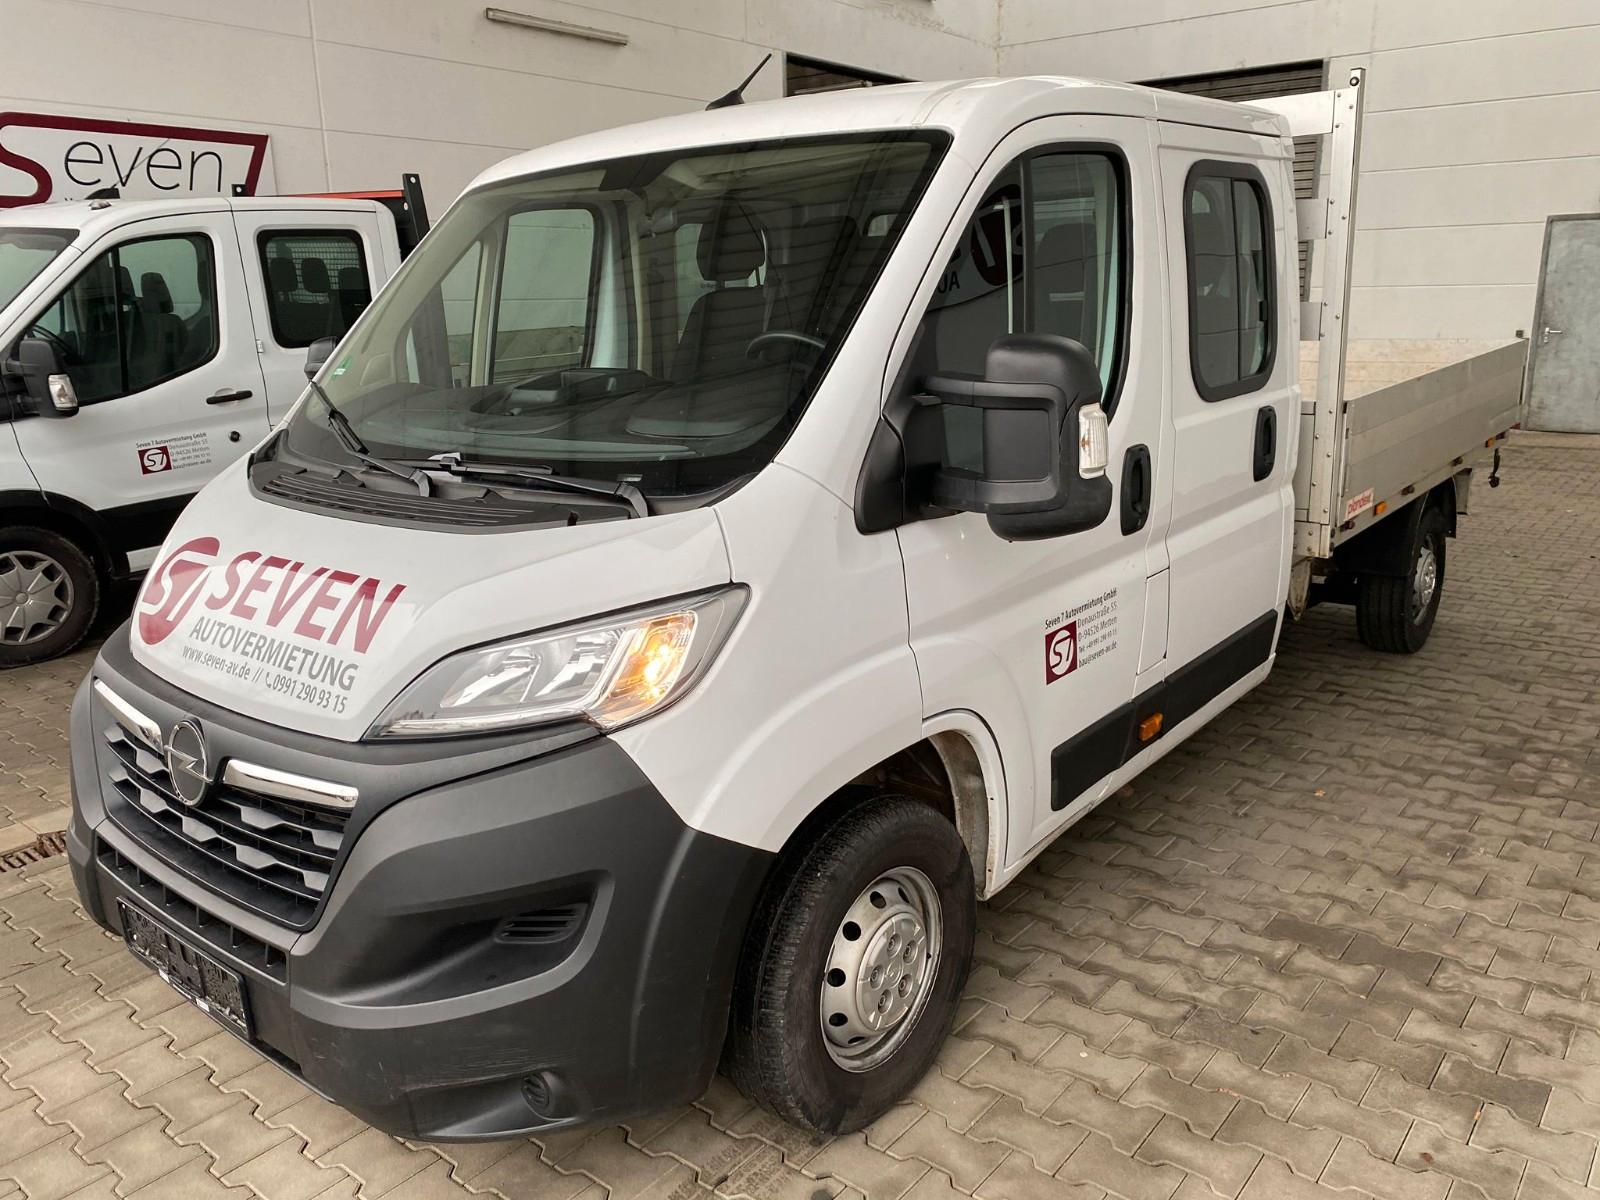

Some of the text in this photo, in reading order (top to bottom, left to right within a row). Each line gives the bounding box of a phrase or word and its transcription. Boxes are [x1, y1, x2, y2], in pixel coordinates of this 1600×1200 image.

[205, 551, 407, 654] SEVEN
[1045, 616, 1060, 630] Seven
[1065, 596, 1103, 619] Autovermietung
[1103, 587, 1117, 602] GmbH
[1078, 601, 1117, 628] Donaustraße 55
[1101, 616, 1117, 631] Metten
[182, 645, 250, 681] www.seven-av.de
[272, 674, 297, 697] 0991
[296, 683, 317, 704] 290
[317, 690, 332, 709] 93
[332, 694, 348, 714] 15
[189, 616, 359, 691] AUTOVERMIETUNG
